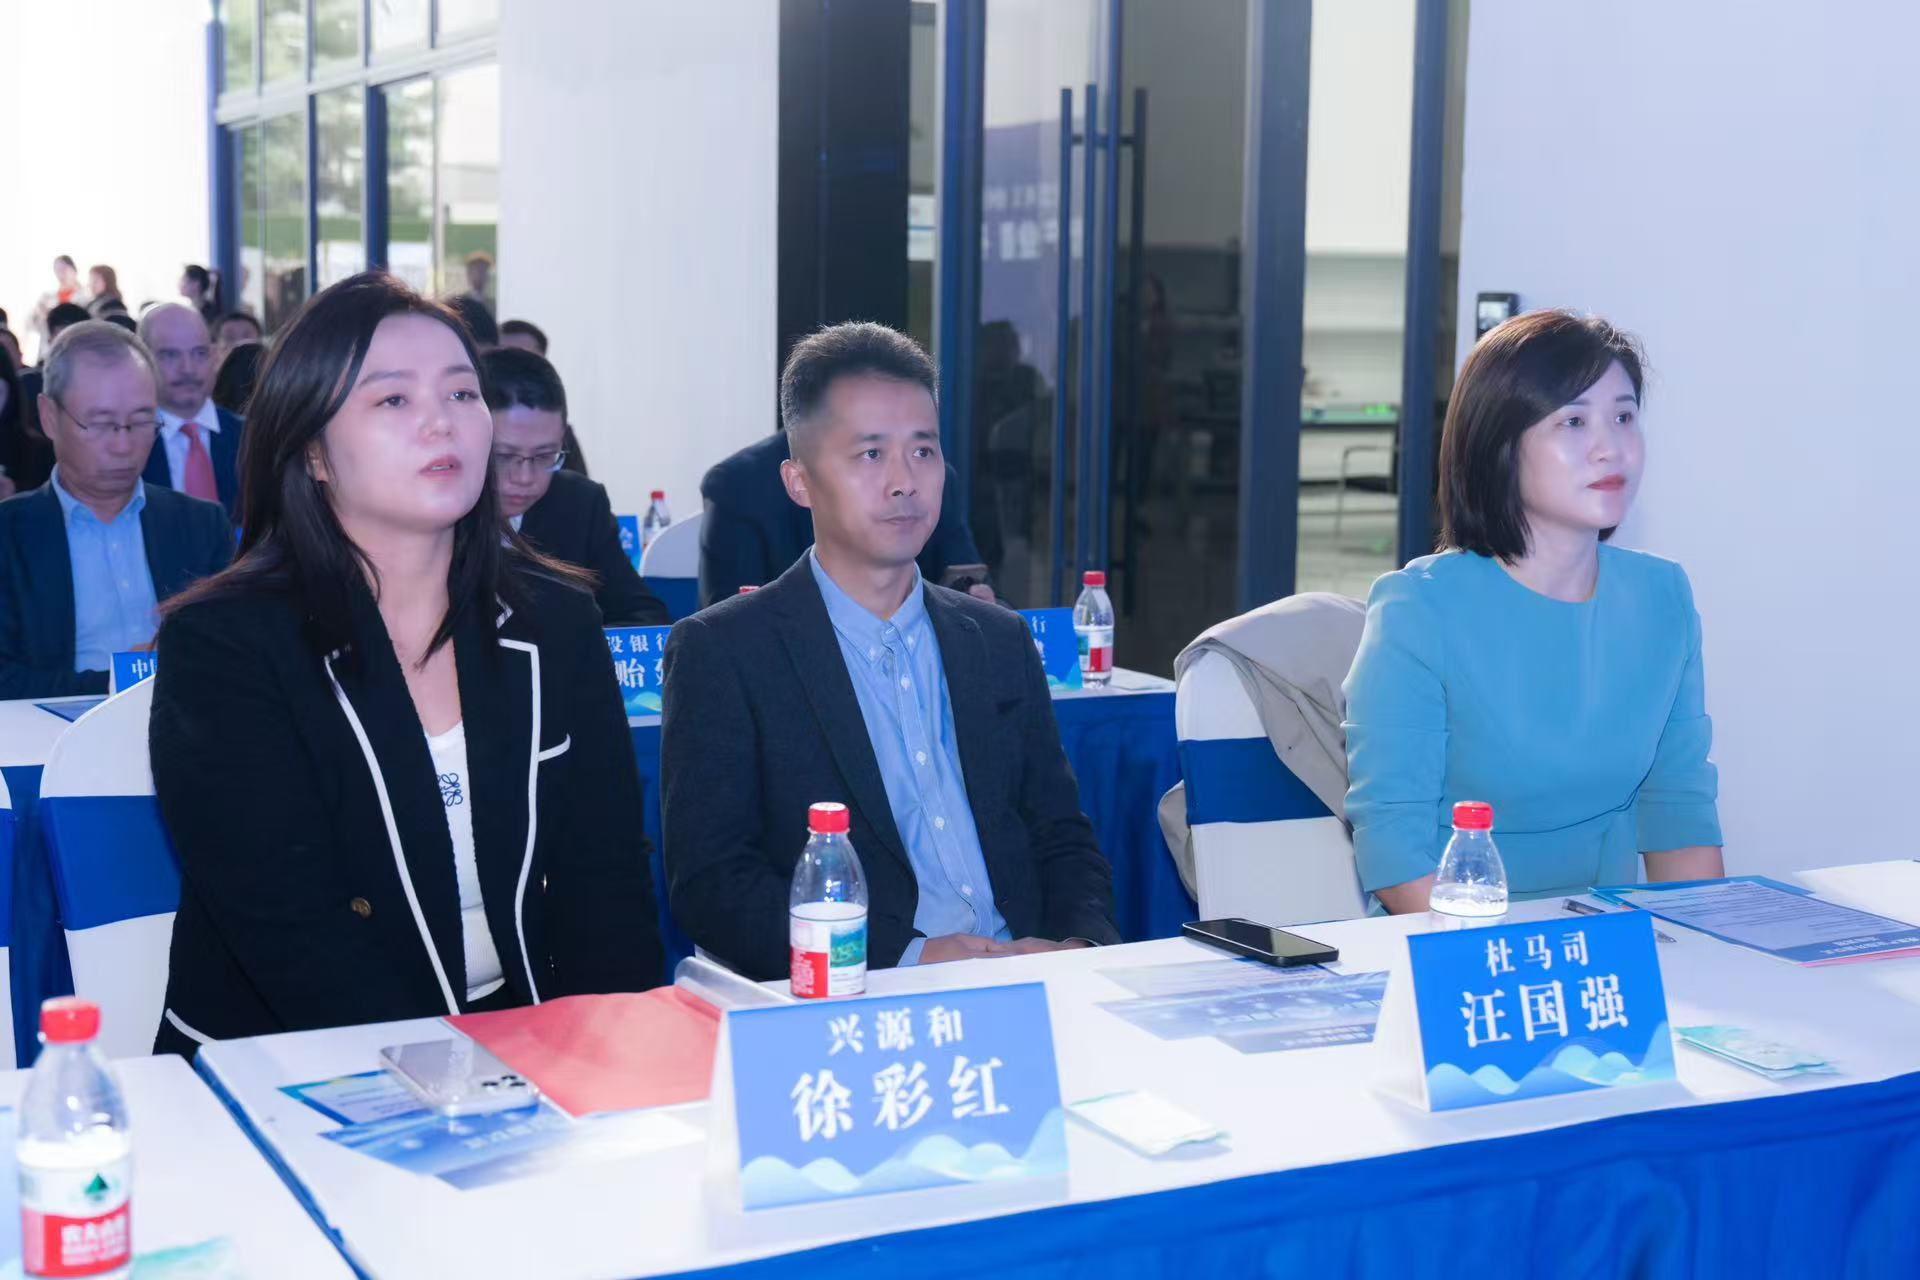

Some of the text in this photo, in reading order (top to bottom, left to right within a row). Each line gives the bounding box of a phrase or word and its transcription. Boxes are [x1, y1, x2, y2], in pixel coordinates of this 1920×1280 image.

[132, 658, 155, 679] 中
[1485, 930, 1589, 977] 杜马司
[827, 1005, 963, 1056] 兴源和
[1460, 973, 1629, 1048] 汪国强
[789, 1055, 1010, 1142] 徐彩红
